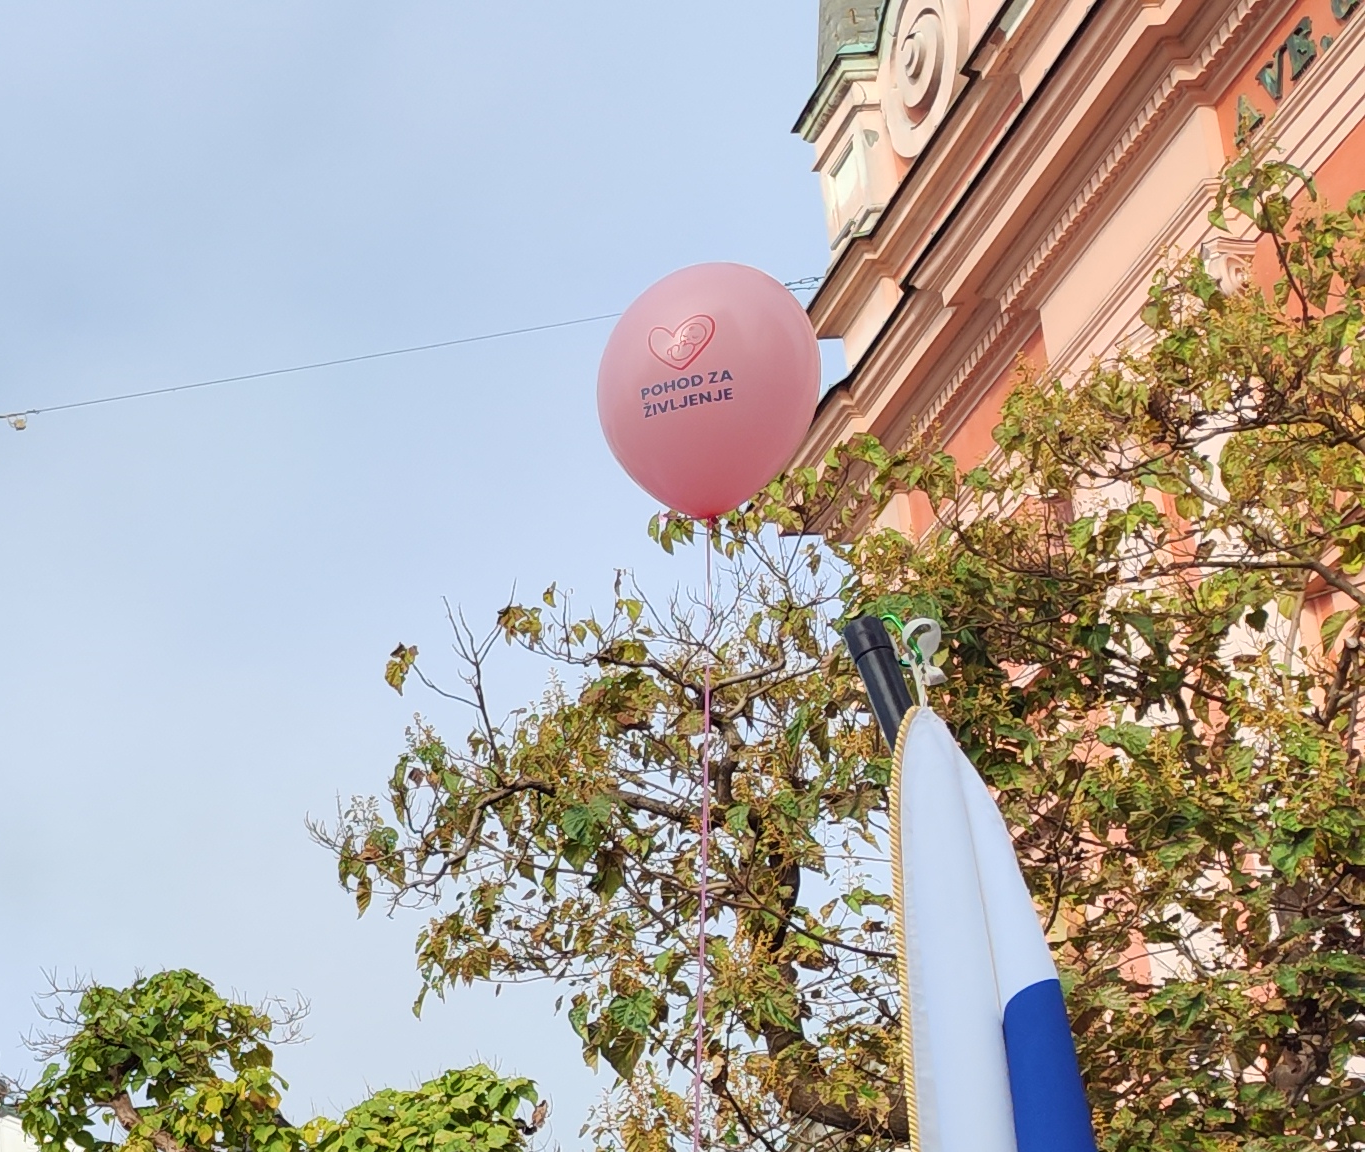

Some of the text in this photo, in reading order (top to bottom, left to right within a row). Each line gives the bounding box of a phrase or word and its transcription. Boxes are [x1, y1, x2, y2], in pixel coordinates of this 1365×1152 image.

[640, 369, 734, 400] POHOD ZA
[643, 387, 734, 418] ŽIVLJENJE
